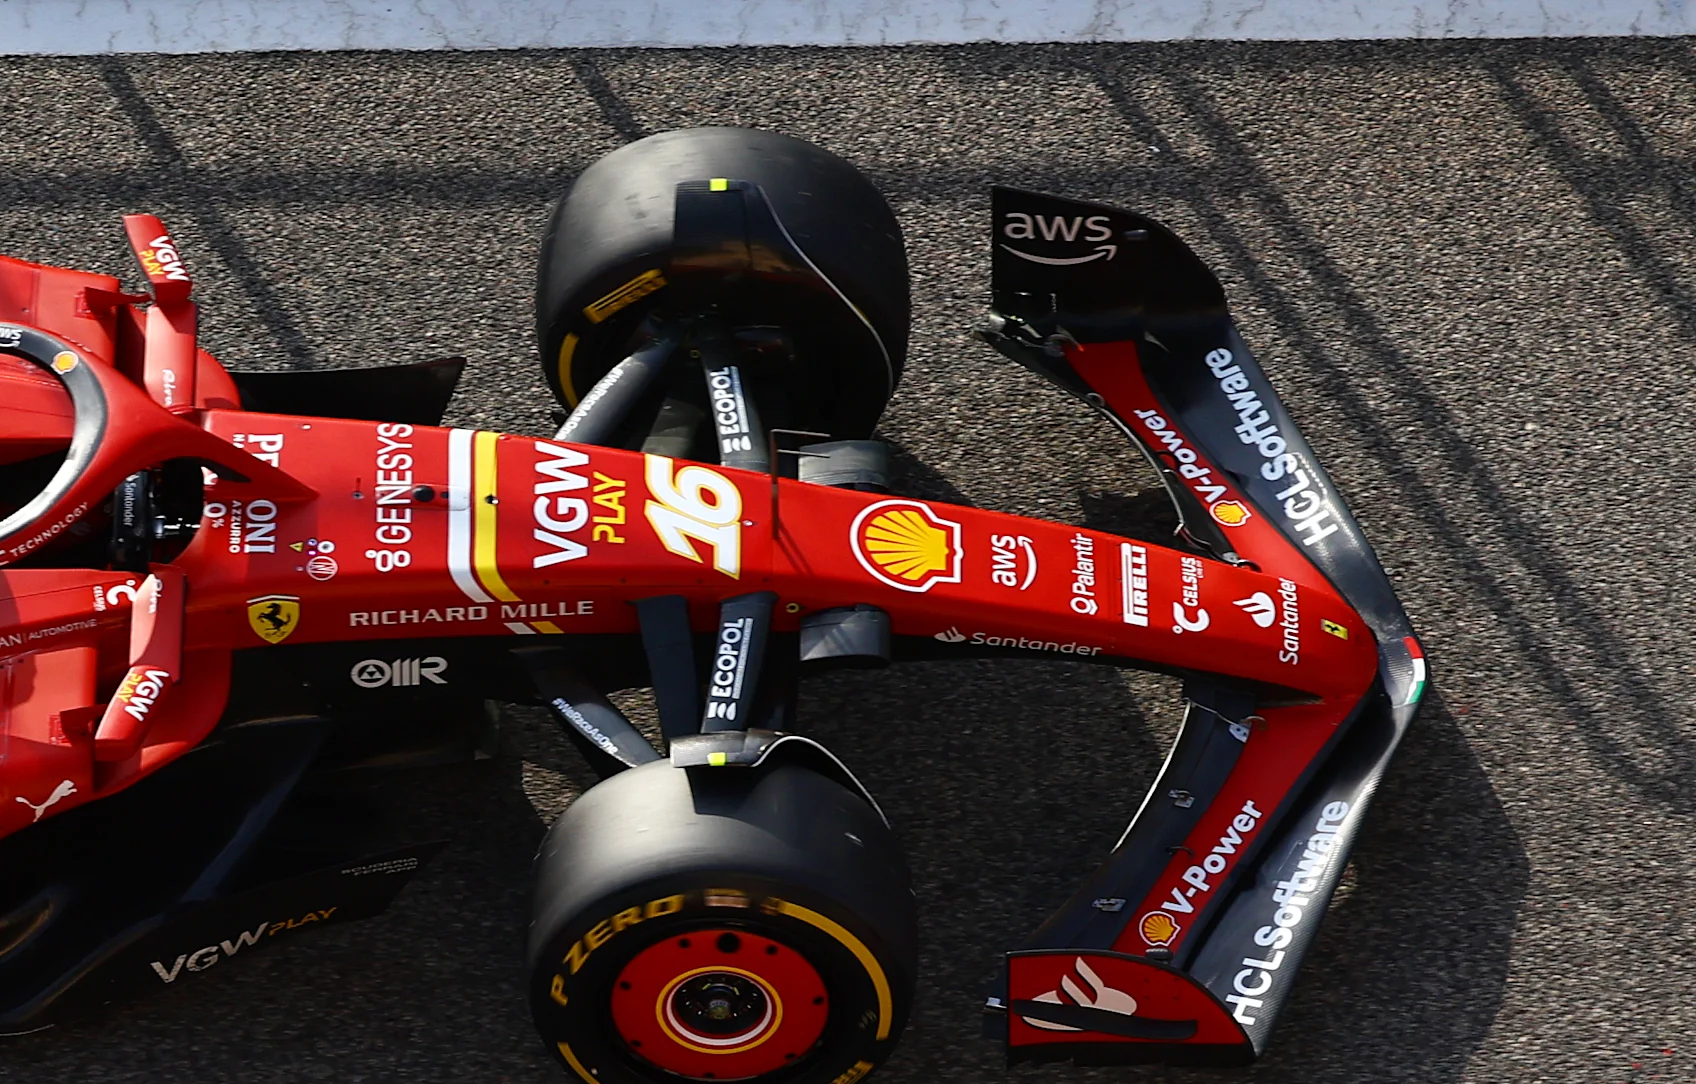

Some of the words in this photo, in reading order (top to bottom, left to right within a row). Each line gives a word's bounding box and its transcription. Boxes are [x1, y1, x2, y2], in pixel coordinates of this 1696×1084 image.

[150, 235, 190, 281] VGW
[1004, 212, 1113, 242] aws
[139, 250, 164, 275] PLAY
[710, 366, 740, 435] ECOPOL
[1133, 409, 1228, 504] V-Power
[1205, 347, 1339, 546] HCLSoftware
[124, 482, 136, 527] Santander
[375, 423, 414, 544] GENESYS
[533, 441, 590, 569] VGW
[592, 471, 626, 544] PLAY
[644, 453, 743, 580] 16
[9, 501, 89, 557] TECHNOLOGY
[229, 500, 242, 553] AZZURRO
[991, 534, 1017, 587] aws
[1070, 533, 1095, 596] Palantir
[1121, 542, 1148, 627] PIRELLI
[1181, 557, 1198, 607] CELSIUS
[28, 619, 97, 640] AUTOMOTIVE
[349, 605, 488, 627] RICHARD
[501, 601, 594, 618] MILLE
[970, 632, 1102, 656] Santander
[1277, 578, 1300, 665] Santander
[117, 672, 143, 703] PLAY
[711, 618, 744, 698] ECOPOL
[124, 670, 170, 722] VGW
[1161, 799, 1262, 914] V-Power
[150, 922, 270, 983] VGW
[269, 907, 337, 936] PLAY
[1225, 800, 1349, 1026] HCLSoftware
[550, 974, 568, 1006] P
[562, 894, 685, 975] ZERO
